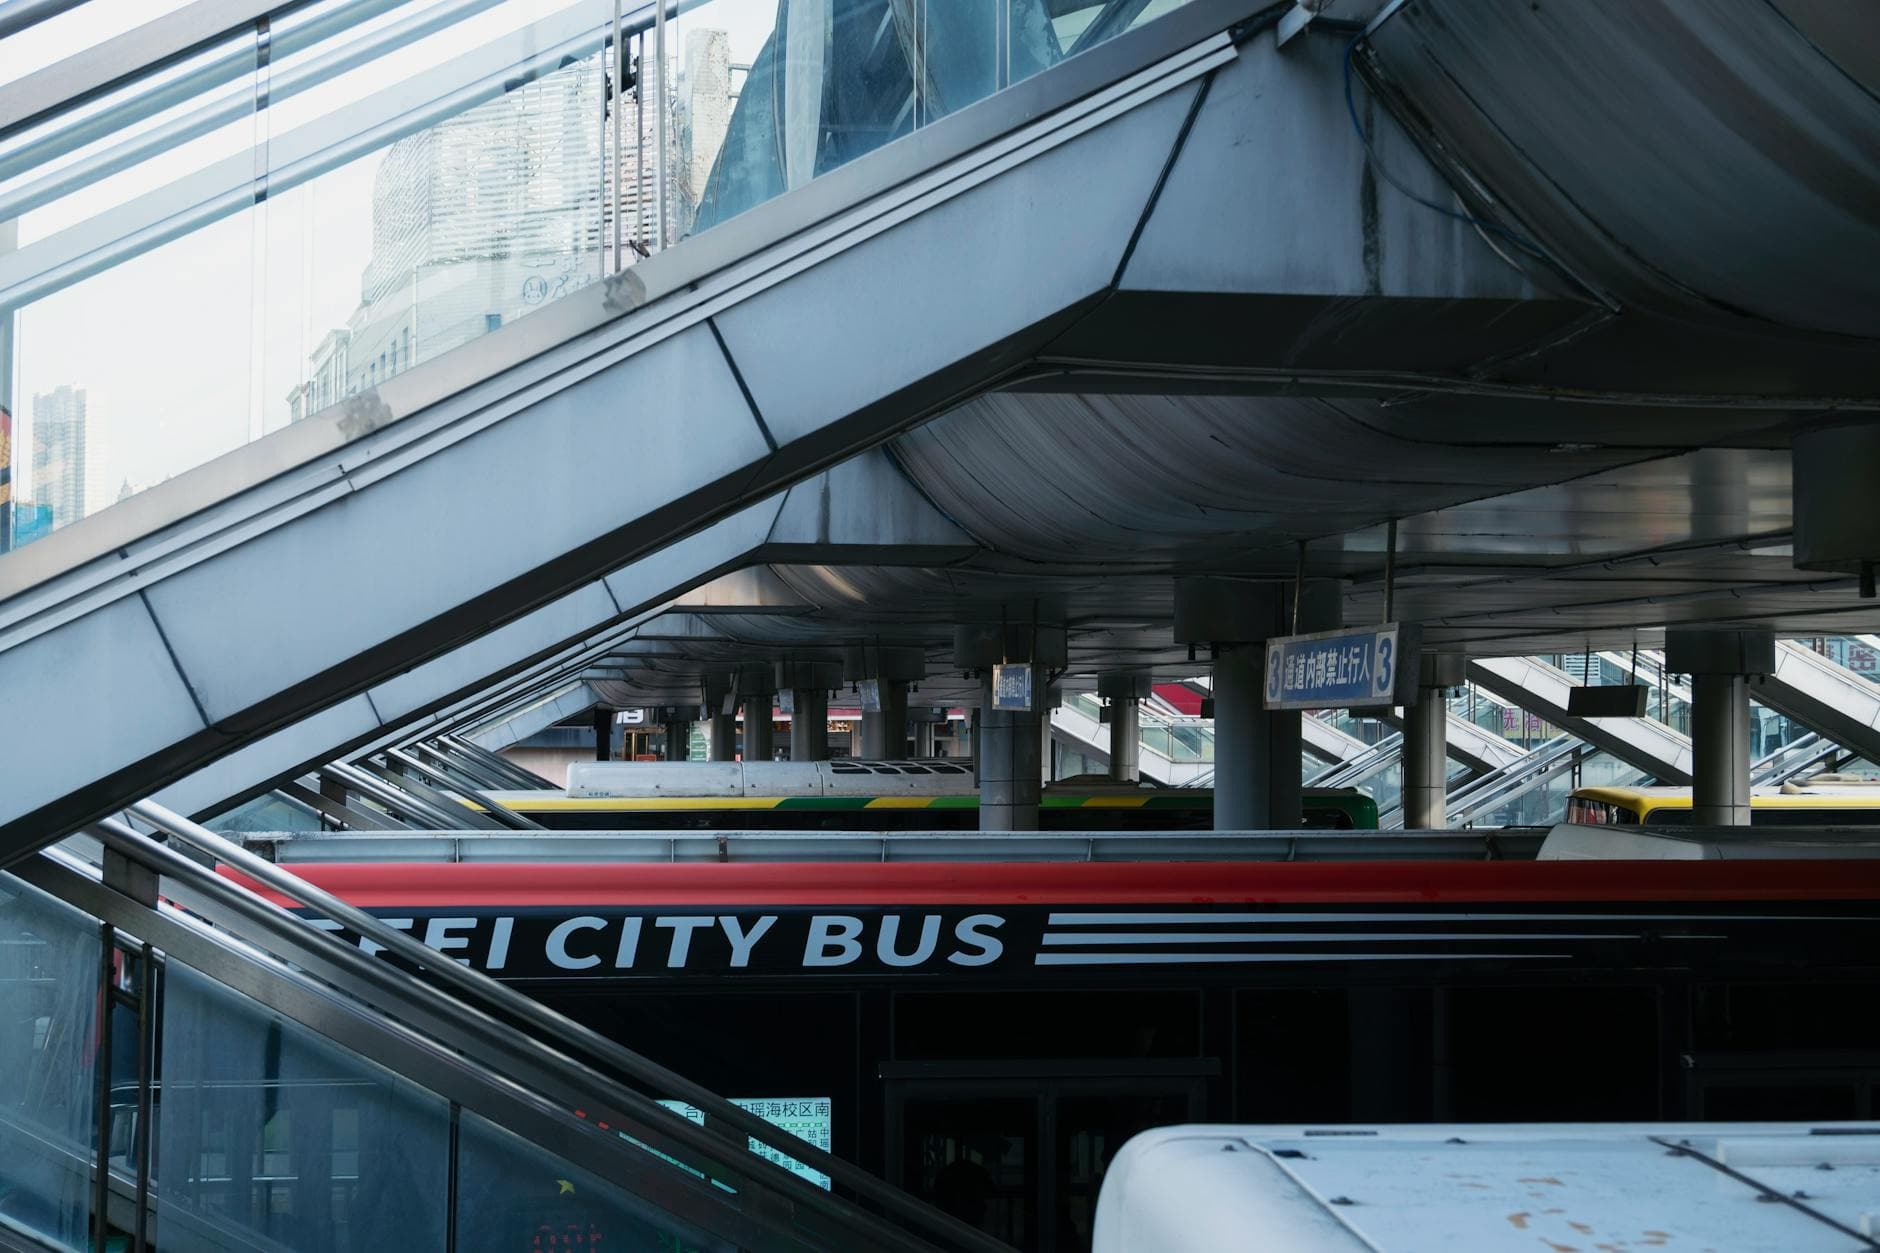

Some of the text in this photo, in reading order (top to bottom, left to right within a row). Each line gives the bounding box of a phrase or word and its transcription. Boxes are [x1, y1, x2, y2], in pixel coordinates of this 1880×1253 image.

[1268, 637, 1392, 698] 3 通道内部禁止行人 3
[545, 916, 779, 970] CITY
[802, 914, 1006, 967] BUS
